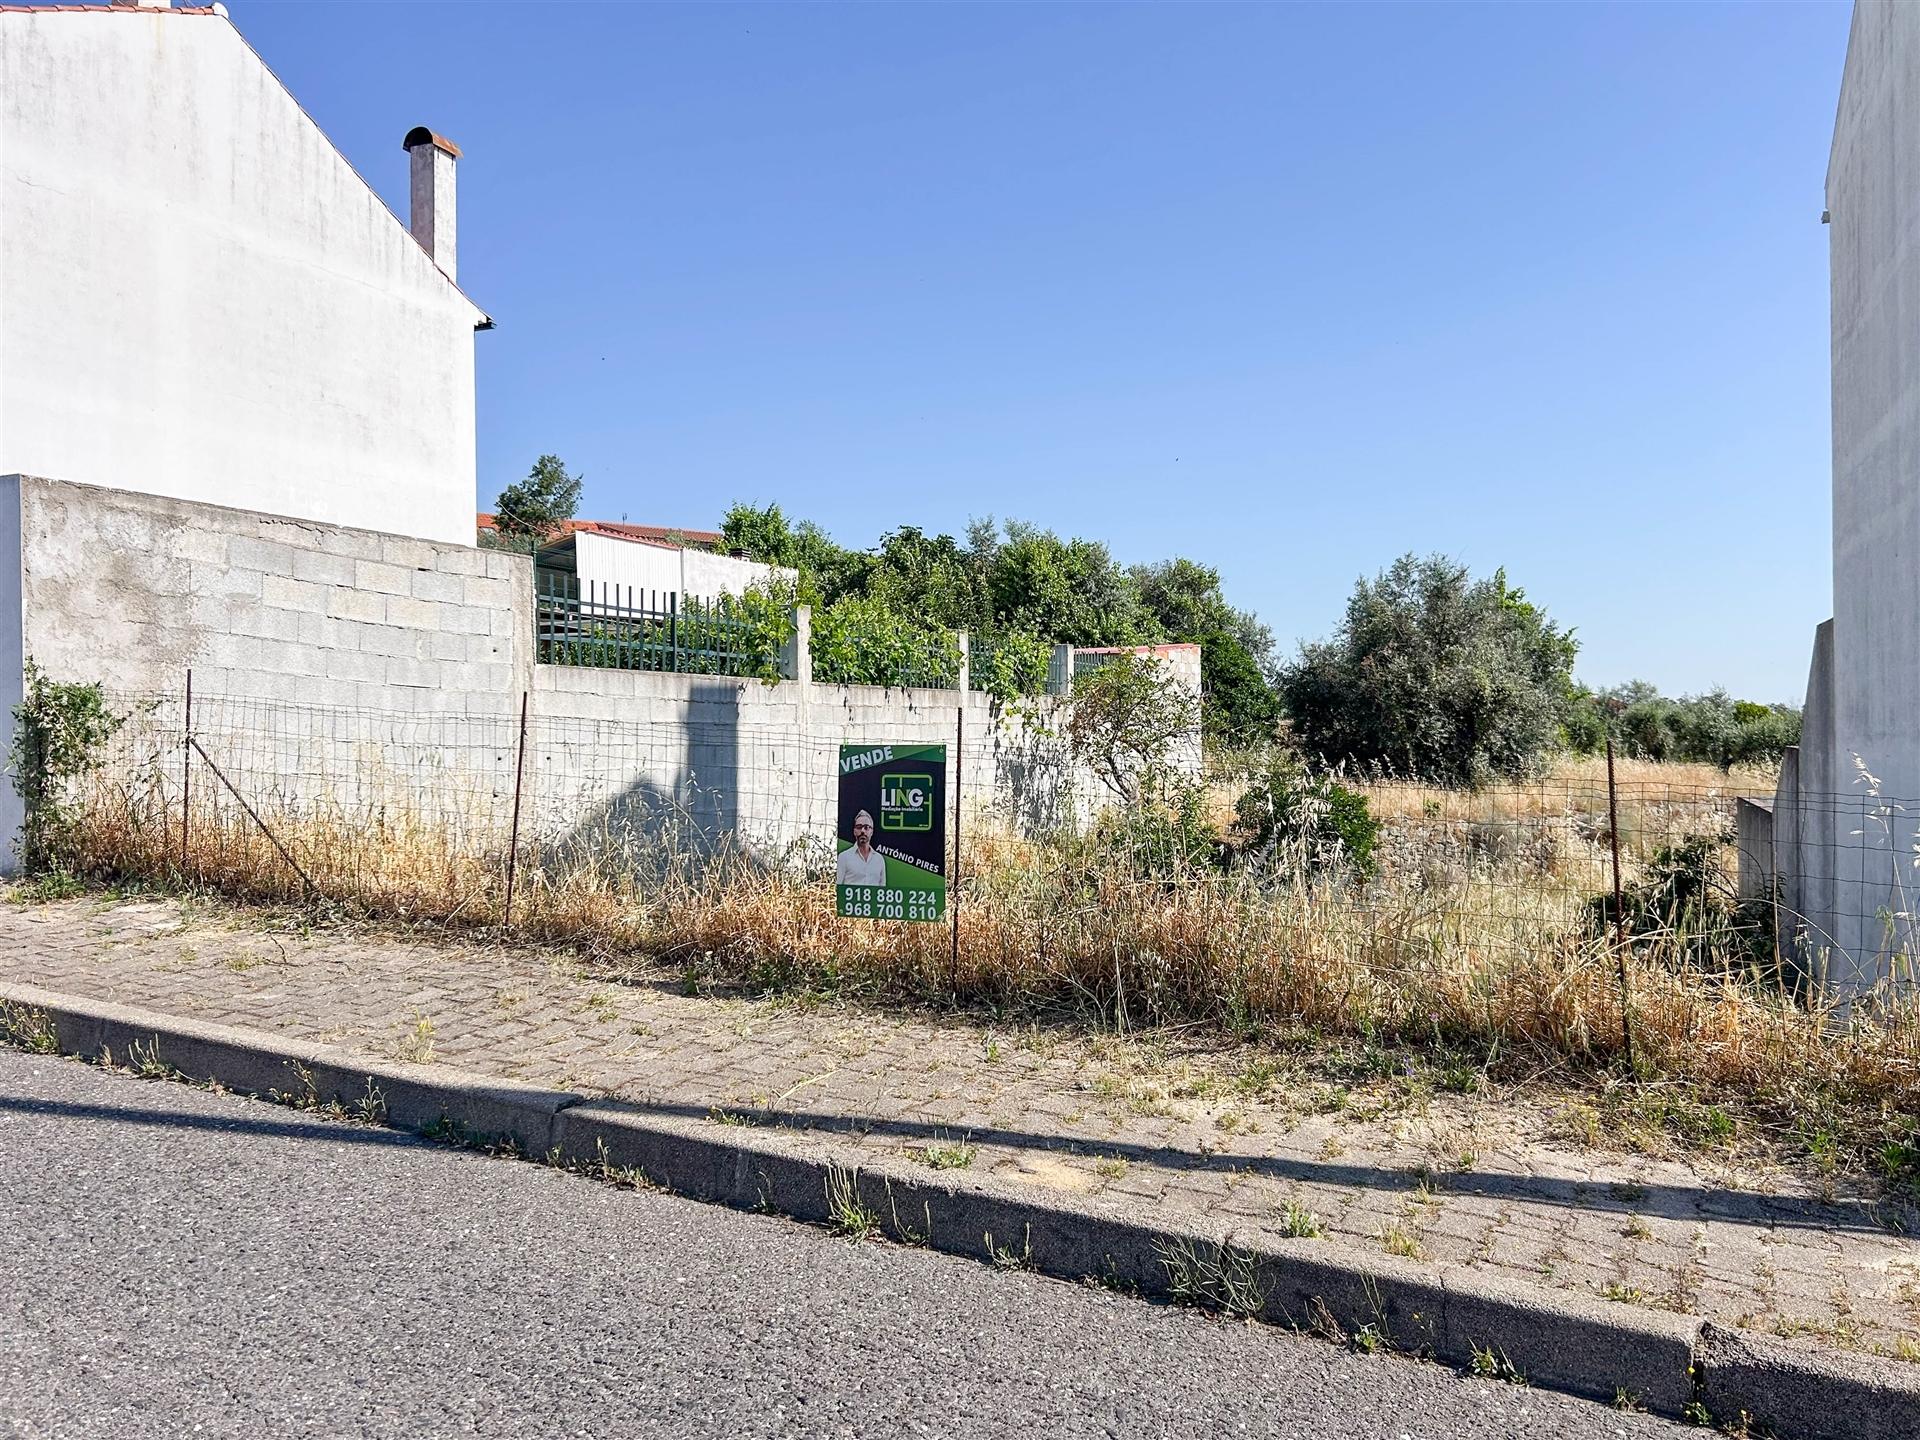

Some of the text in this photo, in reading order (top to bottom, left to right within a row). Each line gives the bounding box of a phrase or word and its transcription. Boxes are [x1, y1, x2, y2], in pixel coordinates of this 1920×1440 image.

[840, 746, 894, 773] VENDE
[881, 788, 924, 807] LING
[876, 844, 939, 873] ANTÓNIO PIRES
[845, 887, 936, 905] 918 880 224
[845, 902, 871, 917] 968
[877, 904, 903, 918] 700
[909, 905, 936, 920] 810
